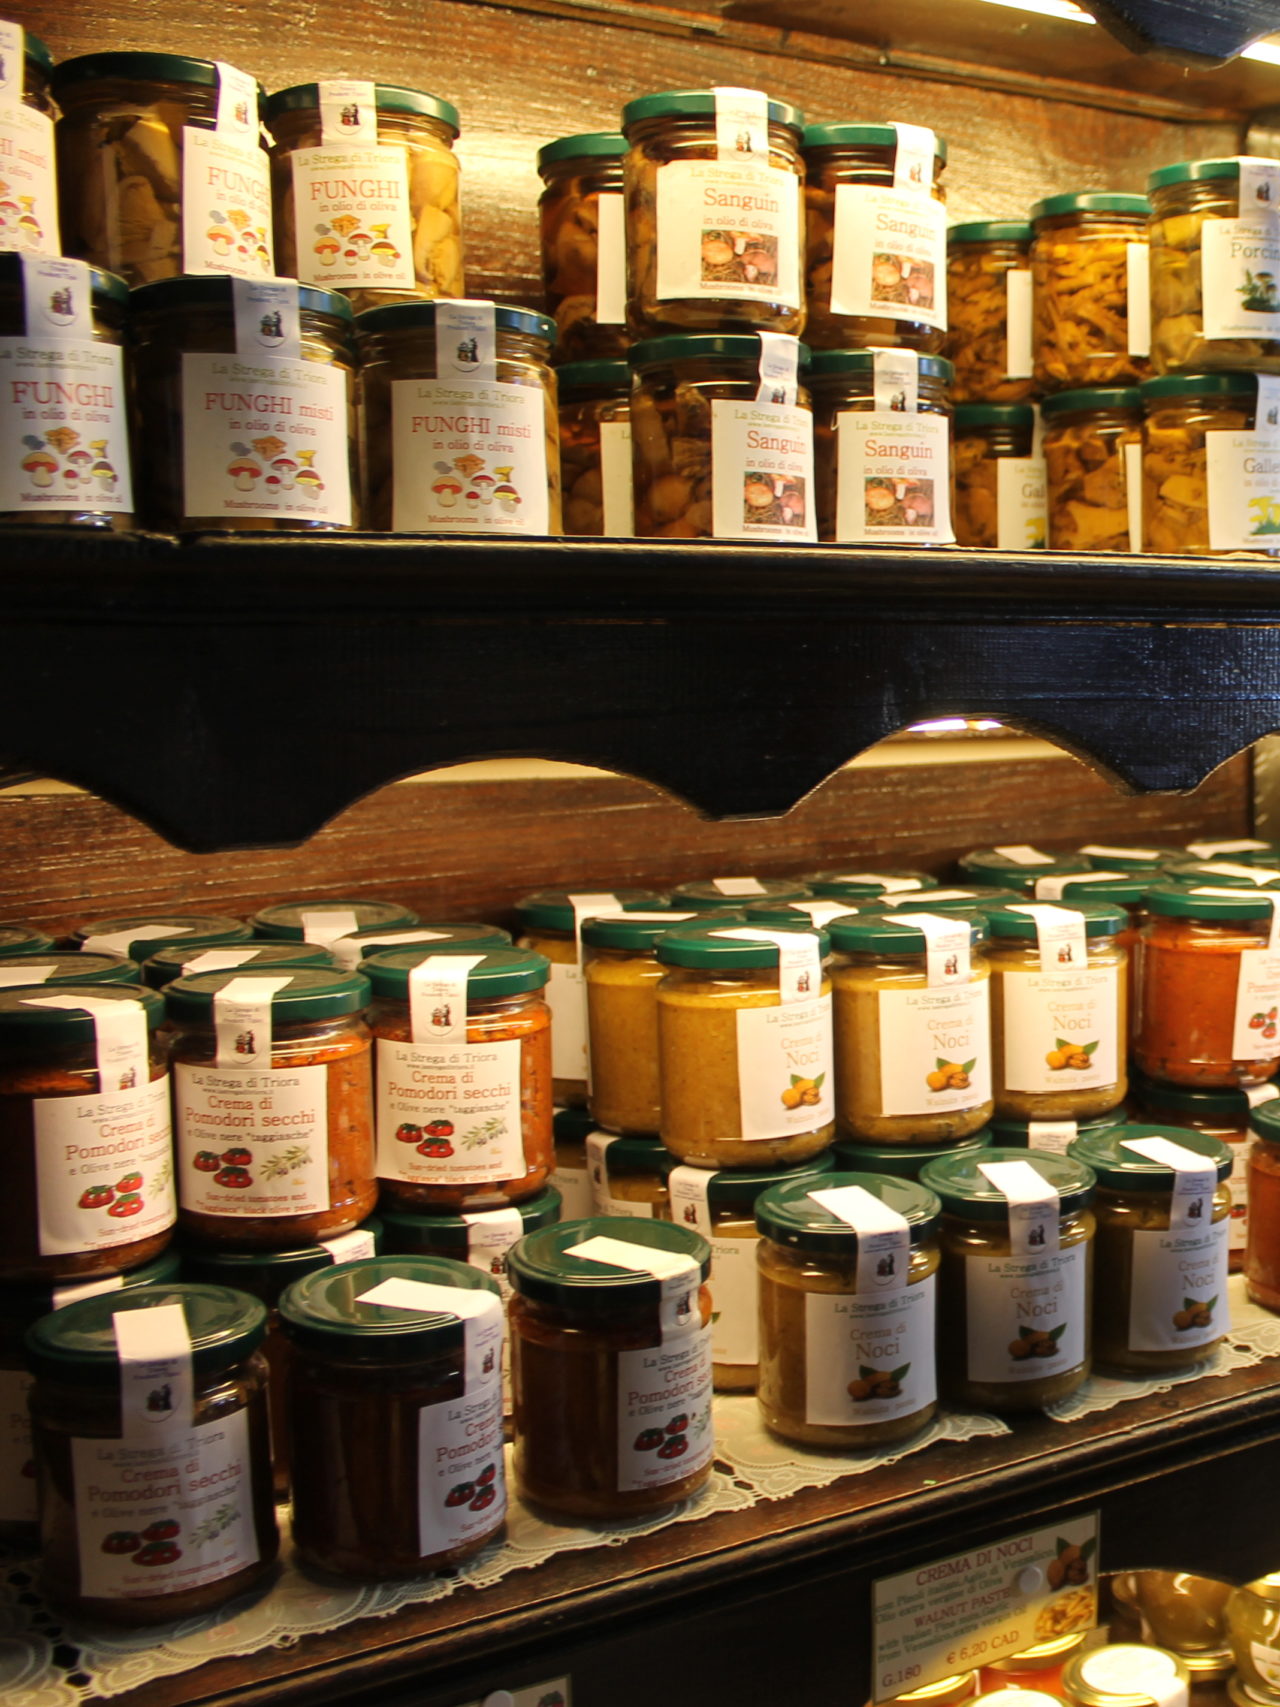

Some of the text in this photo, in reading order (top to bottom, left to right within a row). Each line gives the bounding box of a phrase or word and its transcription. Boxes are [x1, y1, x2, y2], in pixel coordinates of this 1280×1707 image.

[310, 179, 400, 201] FUNGHI
[319, 201, 397, 213] in olio di oliva
[703, 188, 779, 213] Sanguin
[703, 215, 774, 231] in olio di oliva
[10, 381, 115, 408] FUNGHI
[204, 392, 335, 421] FUNGHI misti
[229, 418, 317, 436] in olio di oliva
[411, 416, 532, 438] FUNGHI misti
[433, 439, 514, 453] in olio di oliva
[747, 430, 806, 455] Sanguin
[864, 440, 933, 459] Sanguin
[864, 466, 927, 476] in olio di oliva
[1052, 1014, 1091, 1032] Noci
[933, 1032, 970, 1051] Noci
[396, 1051, 497, 1065] La Strega di Triora
[786, 1049, 821, 1070] Noci
[191, 1073, 300, 1090] La Strega di Triora
[412, 1070, 474, 1085] Crema di
[387, 1082, 512, 1101] Pomodori secchi
[208, 1095, 272, 1110] Crema di
[397, 1101, 419, 1113] Olive
[422, 1105, 445, 1114] nere
[185, 1107, 316, 1127] Pomodori secchi
[100, 1123, 144, 1138] Crema
[194, 1128, 217, 1141] Olive
[220, 1132, 244, 1143] nere
[65, 1136, 145, 1161] Pomodori
[1178, 1258, 1209, 1272] Crema
[1010, 1279, 1064, 1300] Crema di
[1181, 1272, 1215, 1291] Noci
[1016, 1297, 1058, 1319] Noci
[850, 1321, 907, 1342] Crema di
[855, 1337, 900, 1360] Noci
[643, 1356, 657, 1369] La
[664, 1363, 699, 1384] Crema
[628, 1378, 694, 1406] Pomodori
[639, 1402, 665, 1417] Olive
[88, 1459, 243, 1503] Pomodori secchi
[121, 1458, 200, 1484] Crema di
[915, 1536, 1034, 1586] CREMA DI NOCI
[913, 1587, 1012, 1628] WALNUT PASTE
[990, 1630, 1020, 1651] CAD
[881, 1663, 922, 1689] G.180
